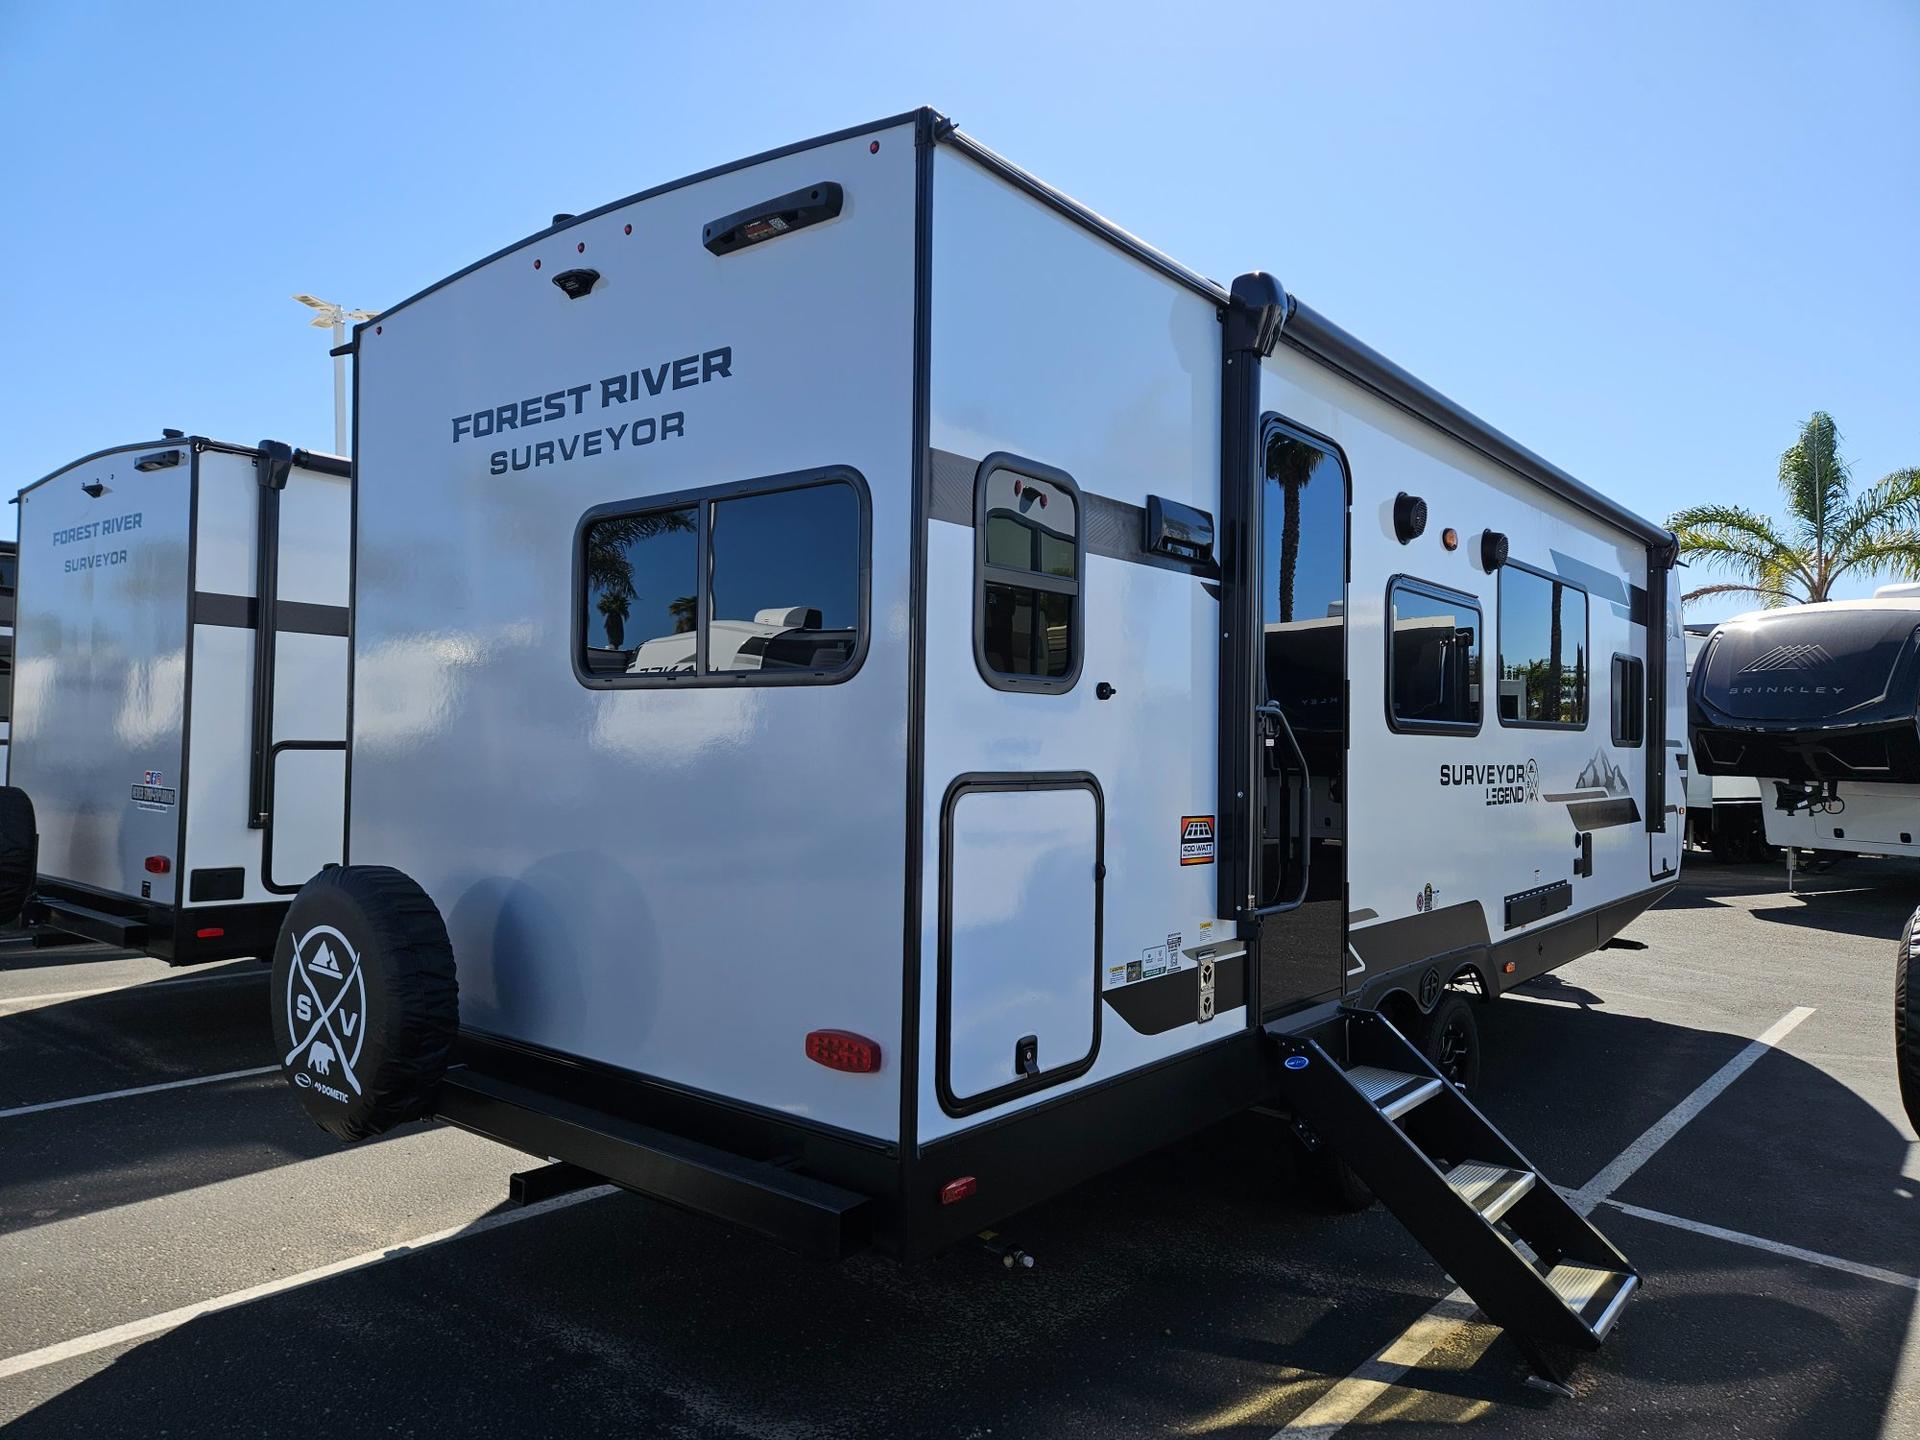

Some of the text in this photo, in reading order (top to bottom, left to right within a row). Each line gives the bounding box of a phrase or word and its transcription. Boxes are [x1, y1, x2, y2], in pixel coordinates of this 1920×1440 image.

[452, 346, 732, 443] FOREST RIVER
[490, 411, 685, 475] SURVEYOR
[52, 512, 143, 546] FOREST RIVER
[64, 549, 128, 573] SURVEYOR
[1440, 764, 1525, 786] SURVEYOR
[1486, 786, 1524, 806] LEGEND
[1196, 844, 1213, 852] WATT
[296, 994, 358, 1037] S V
[321, 1084, 349, 1104] DOMETIC
